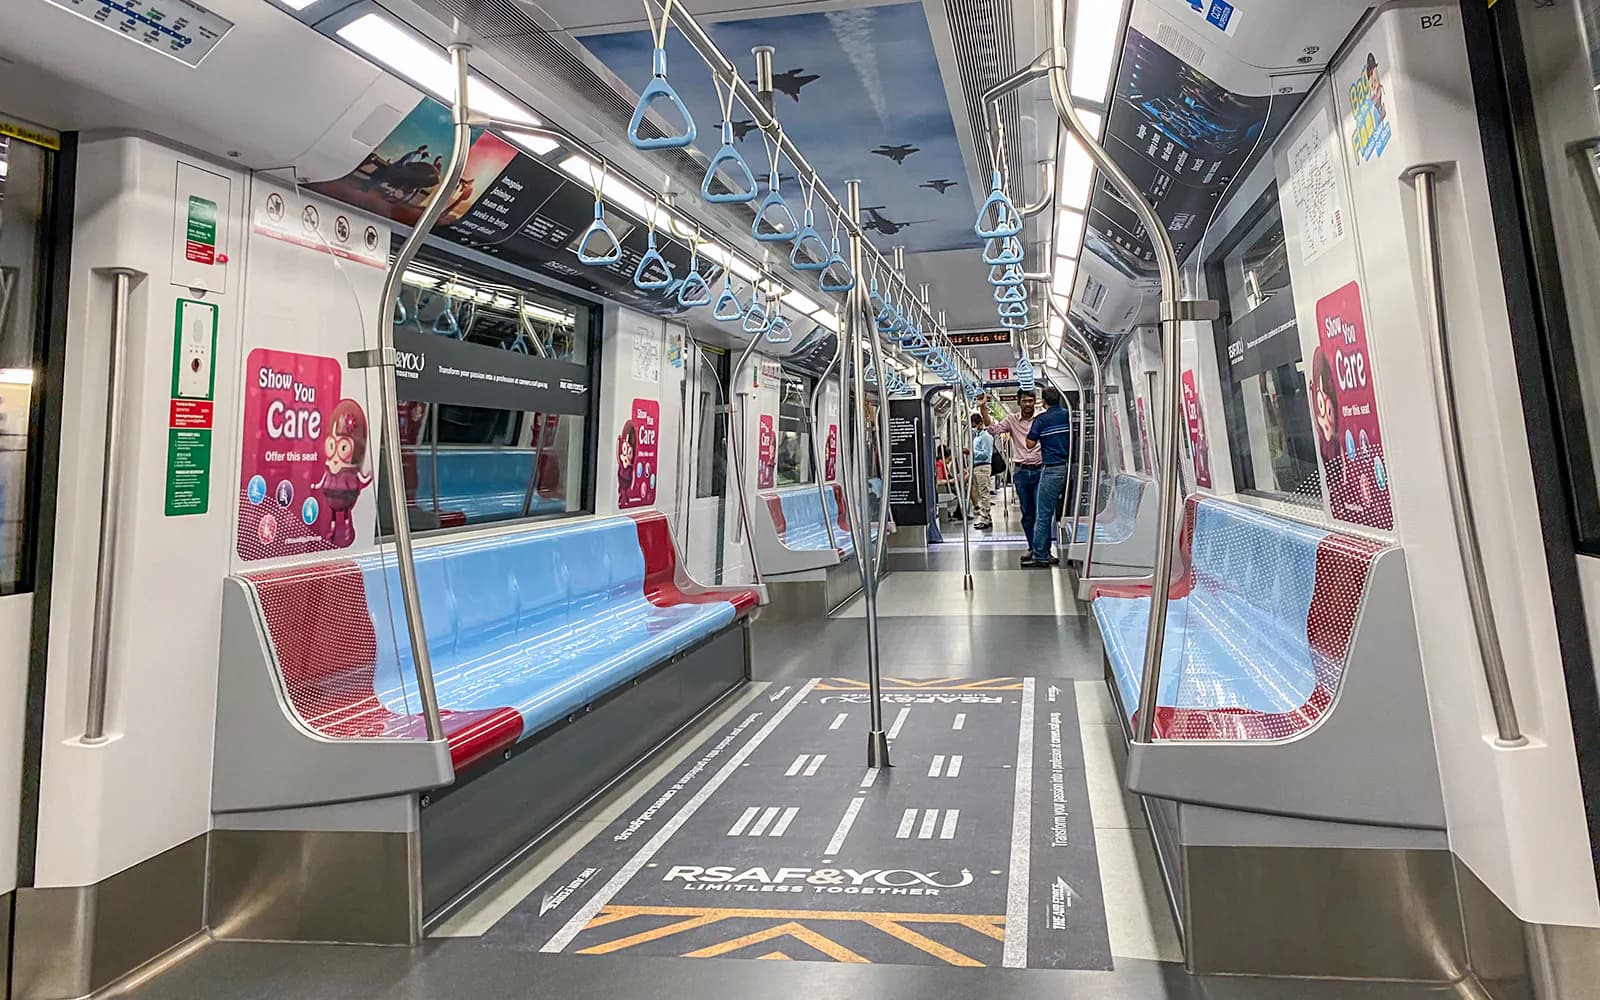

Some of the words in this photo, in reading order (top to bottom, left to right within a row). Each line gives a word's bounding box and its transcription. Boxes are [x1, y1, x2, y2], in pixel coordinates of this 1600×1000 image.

[1420, 13, 1444, 30] B2
[501, 175, 524, 192] Imagine
[489, 186, 512, 202] joining
[481, 198, 498, 210] team
[495, 204, 510, 215] that
[493, 217, 509, 230] bring
[966, 335, 990, 343] train
[1325, 316, 1342, 339] Show
[1342, 322, 1356, 345] You
[1335, 349, 1367, 391] Care
[258, 367, 293, 390] Show
[293, 382, 316, 403] You
[1360, 402, 1371, 415] seat
[266, 400, 322, 439] Care
[638, 425, 656, 445] Care
[265, 450, 285, 462] Offer
[286, 450, 301, 462] this
[301, 451, 318, 462] seat
[1048, 747, 1065, 769] profession
[1049, 773, 1063, 784] into
[1049, 783, 1068, 803] passion
[1053, 803, 1069, 816] your
[1051, 816, 1069, 848] Transform
[579, 867, 597, 880] THE
[683, 883, 804, 894] LIMITLESS
[813, 886, 941, 896] TOGETHER
[1051, 883, 1065, 904] FORCE
[1052, 903, 1066, 915] AIR
[1052, 915, 1067, 930] THE
